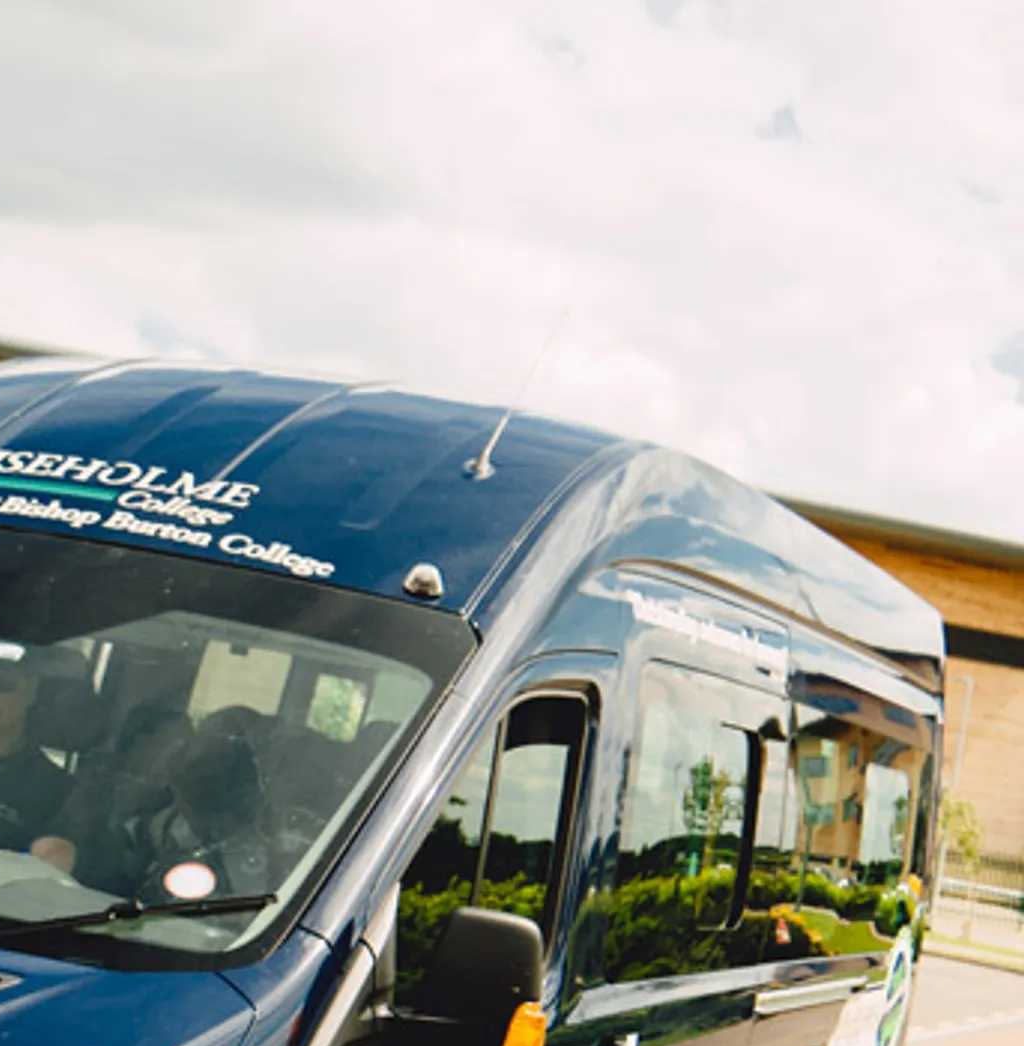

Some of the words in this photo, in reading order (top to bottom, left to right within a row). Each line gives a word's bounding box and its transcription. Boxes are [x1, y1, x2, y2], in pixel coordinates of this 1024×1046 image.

[118, 489, 233, 526] College
[101, 510, 213, 547] Burton
[218, 533, 335, 577] College
